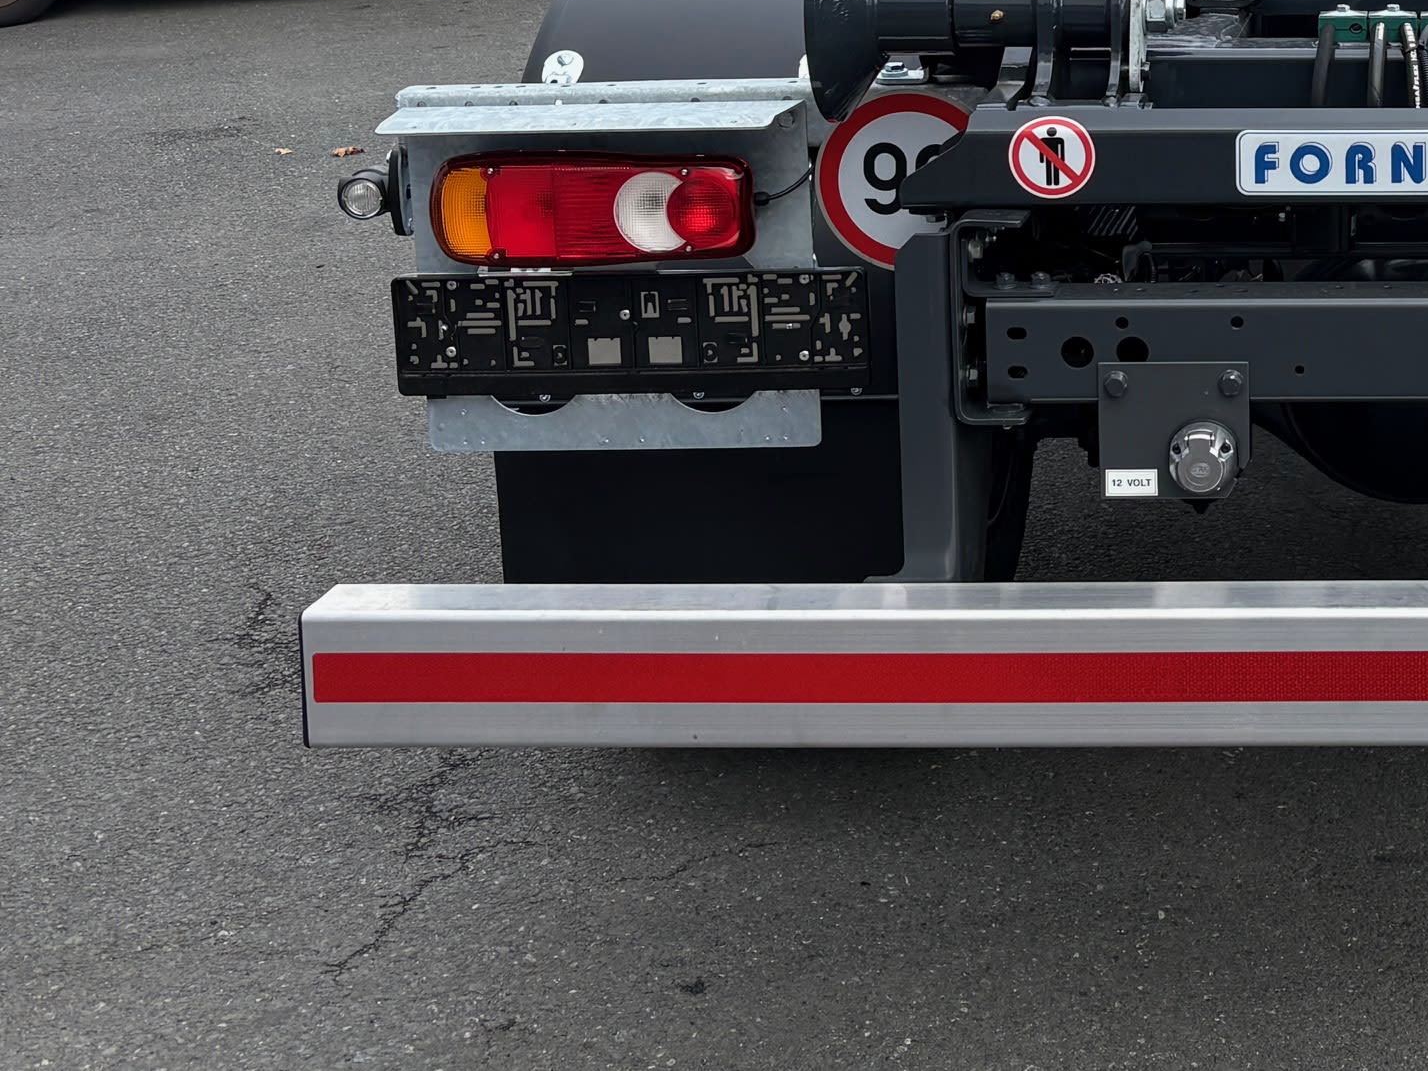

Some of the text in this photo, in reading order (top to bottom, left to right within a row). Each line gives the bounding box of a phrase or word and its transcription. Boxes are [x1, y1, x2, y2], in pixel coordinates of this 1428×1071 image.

[863, 142, 942, 215] 9
[1112, 478, 1152, 487] 12 VOLT
